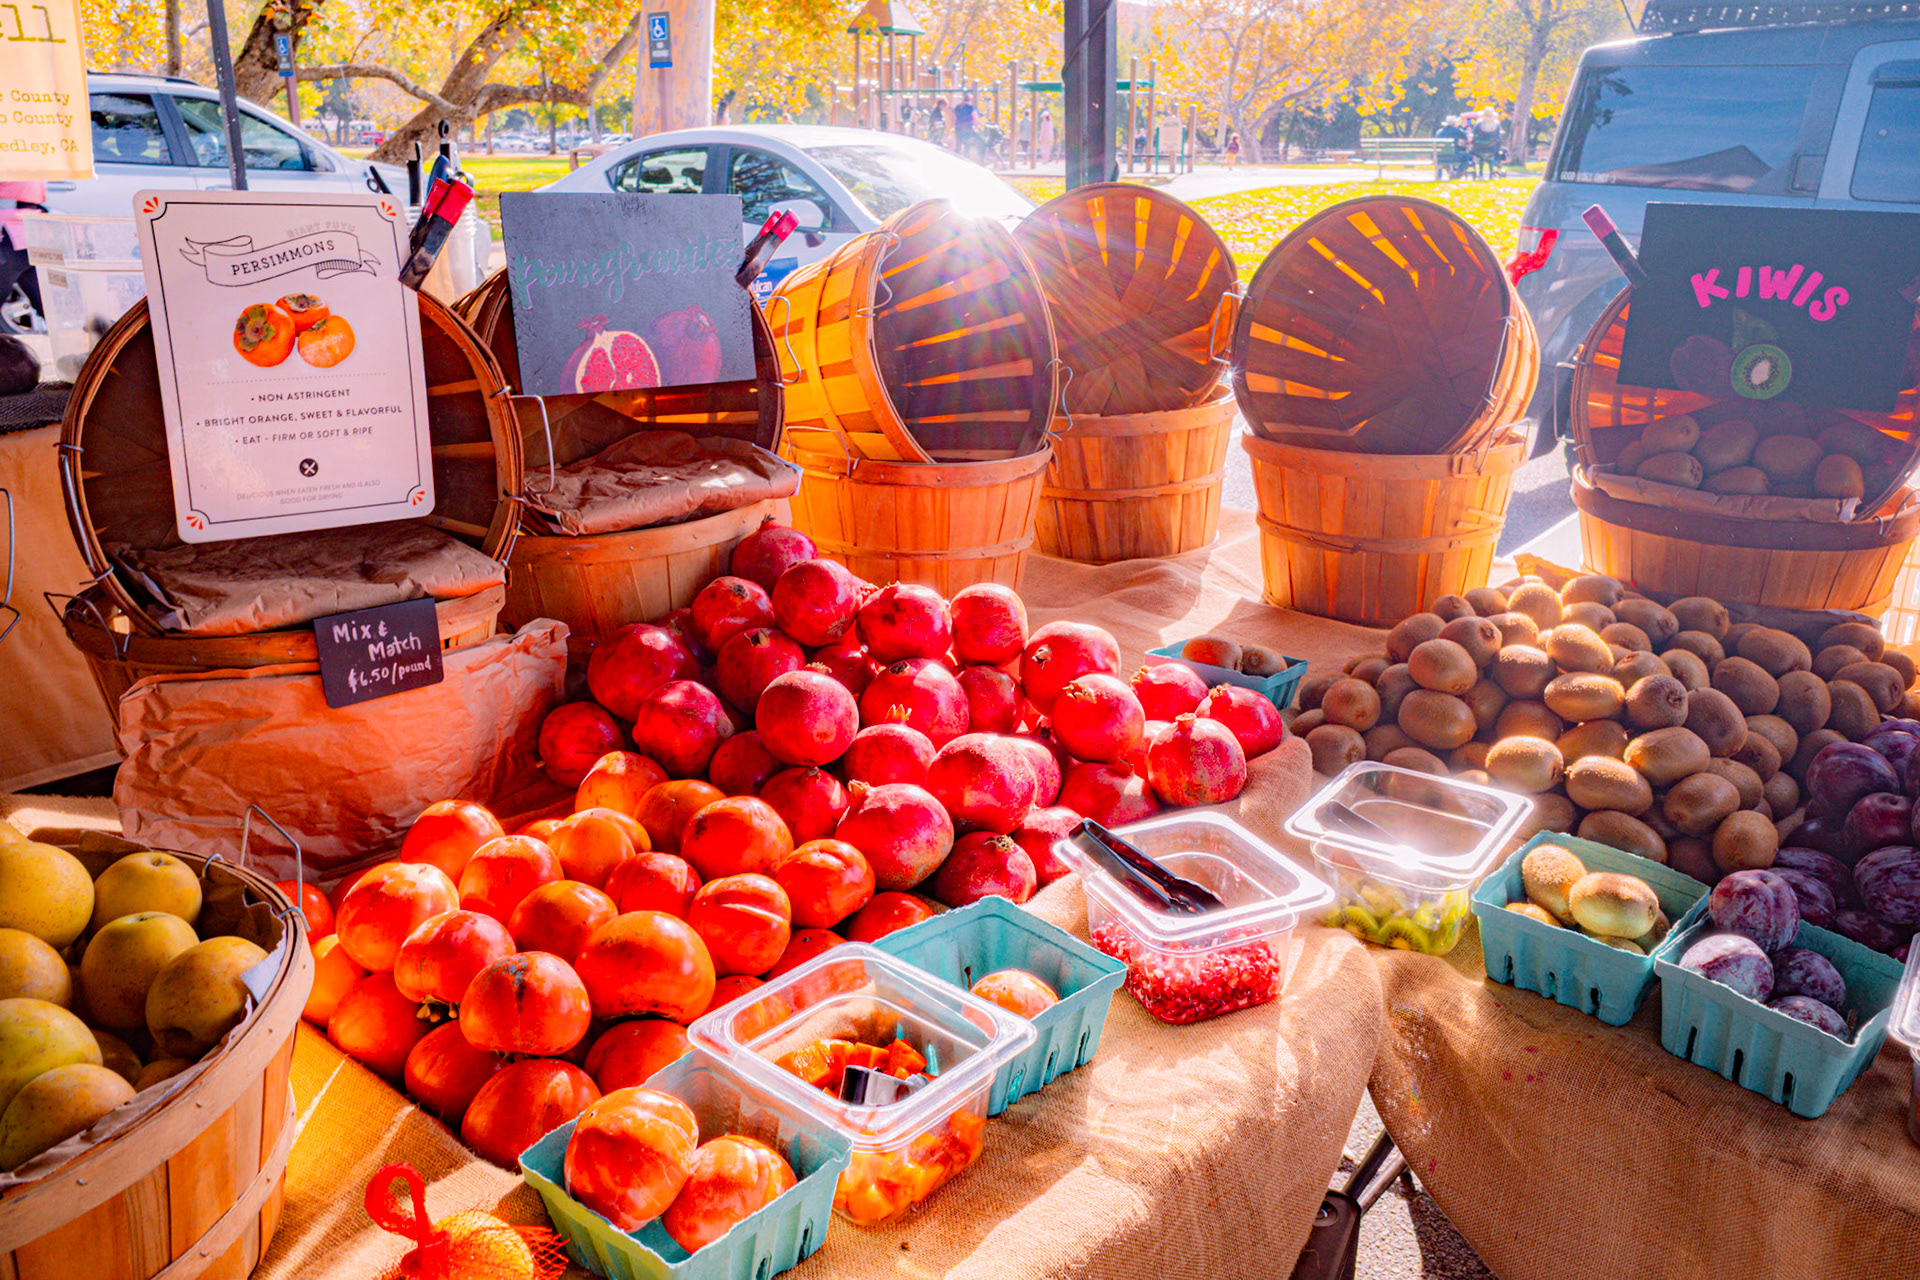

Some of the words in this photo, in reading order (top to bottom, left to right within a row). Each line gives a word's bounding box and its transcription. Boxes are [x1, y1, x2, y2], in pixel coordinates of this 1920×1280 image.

[0, 4, 66, 43] ll
[11, 89, 71, 106] County
[13, 110, 73, 128] County
[60, 138, 79, 153] CA
[231, 239, 335, 276] PERSIMMONS
[750, 279, 773, 294] ulcan
[1690, 264, 1849, 321] KIWIS
[258, 393, 283, 403] NON
[287, 388, 351, 401] ASTRINGENT
[204, 416, 245, 428] BRIGHT
[248, 413, 298, 425] ORANGE,
[300, 410, 333, 421] SWEET
[336, 409, 343, 418] &
[346, 405, 403, 417] FLAVORFUL
[242, 435, 261, 445] EAT
[272, 432, 297, 443] FIRM
[300, 431, 313, 440] OR
[316, 429, 340, 438] SOFT
[343, 428, 350, 436] &
[352, 426, 374, 435] RIPE
[236, 490, 274, 501] DELICIOUS
[276, 488, 296, 496] WHEN
[297, 486, 318, 494] EATEN
[319, 484, 341, 492] FRESH
[365, 479, 381, 487] ALSO
[280, 496, 301, 505] GOOD
[302, 494, 317, 502] FOR
[318, 492, 343, 501] DRYING
[332, 620, 372, 644] Mix
[368, 632, 422, 662] Match
[348, 654, 432, 694] $6.50/pound
